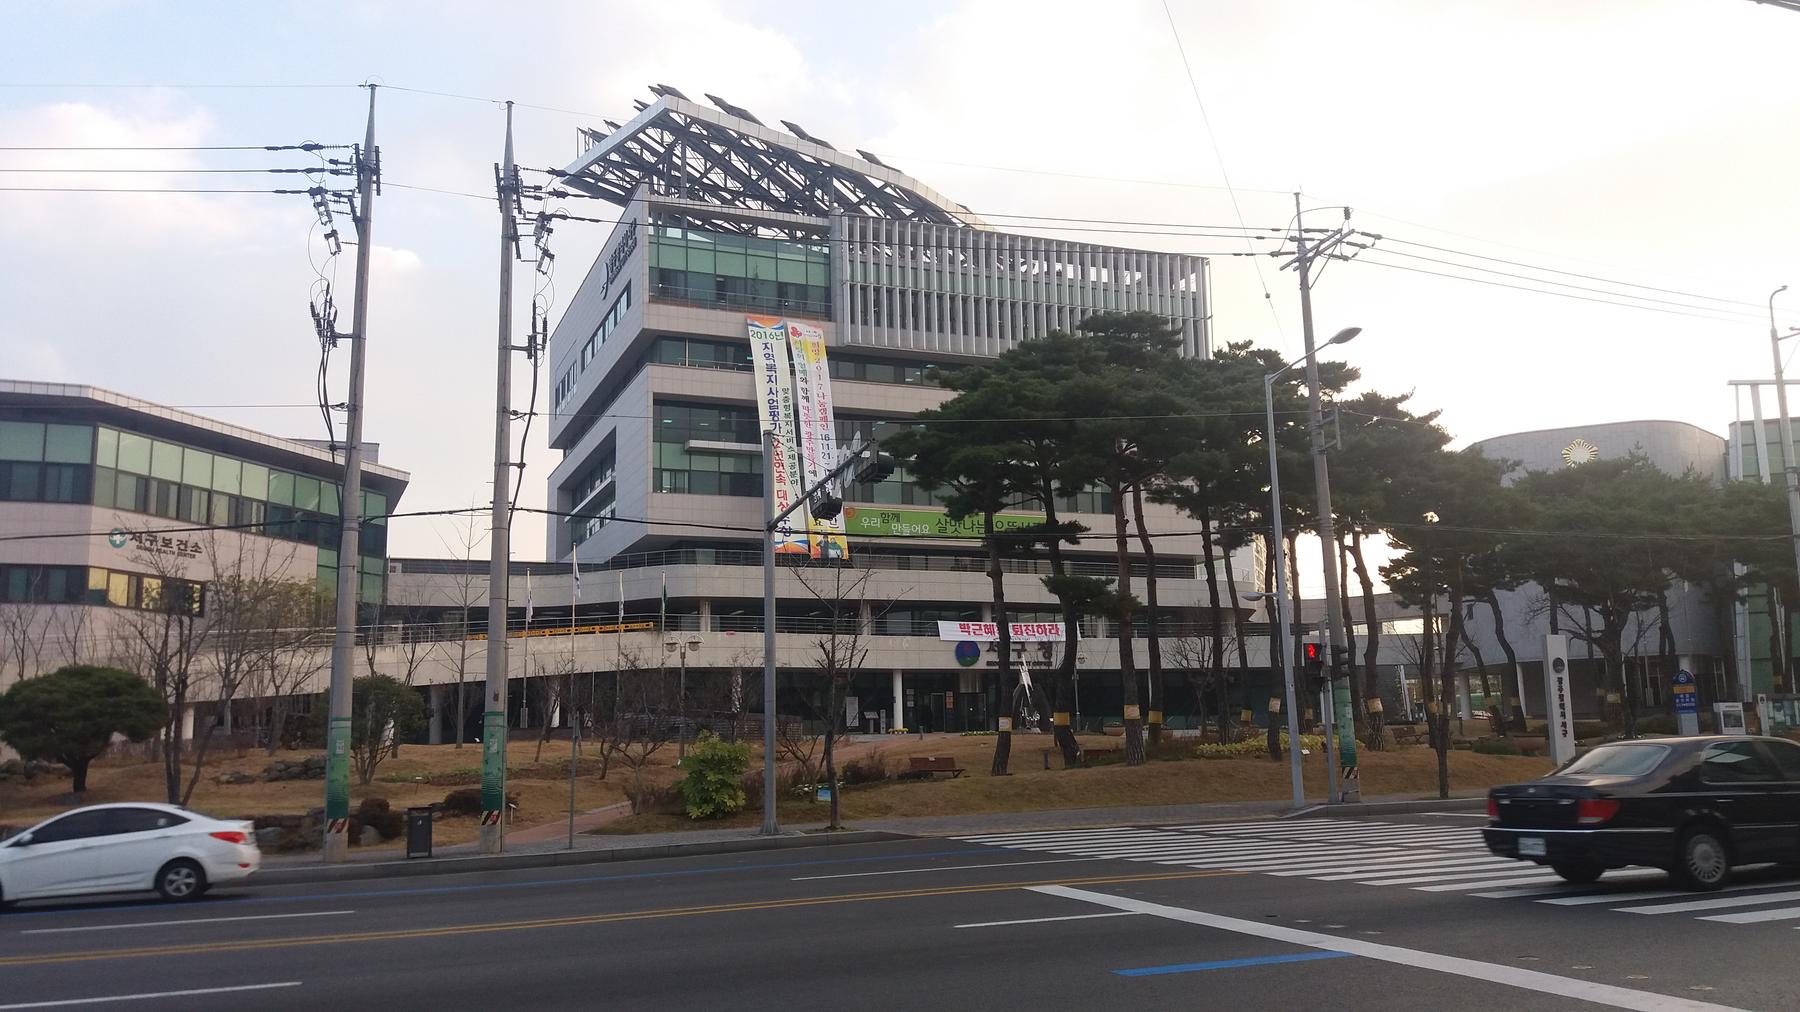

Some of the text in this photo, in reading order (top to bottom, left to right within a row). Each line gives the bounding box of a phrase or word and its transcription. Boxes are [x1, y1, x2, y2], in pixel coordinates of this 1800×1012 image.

[750, 329, 784, 341] 2016년
[762, 342, 782, 434] 지역복지사업평가
[860, 517, 881, 529] 우리
[879, 511, 900, 524] 함께
[891, 523, 930, 536] 만들어요
[935, 517, 985, 535] 살맛나는
[130, 531, 203, 554] 서구보건소
[958, 623, 1061, 637] 박근혜 퇴진하라
